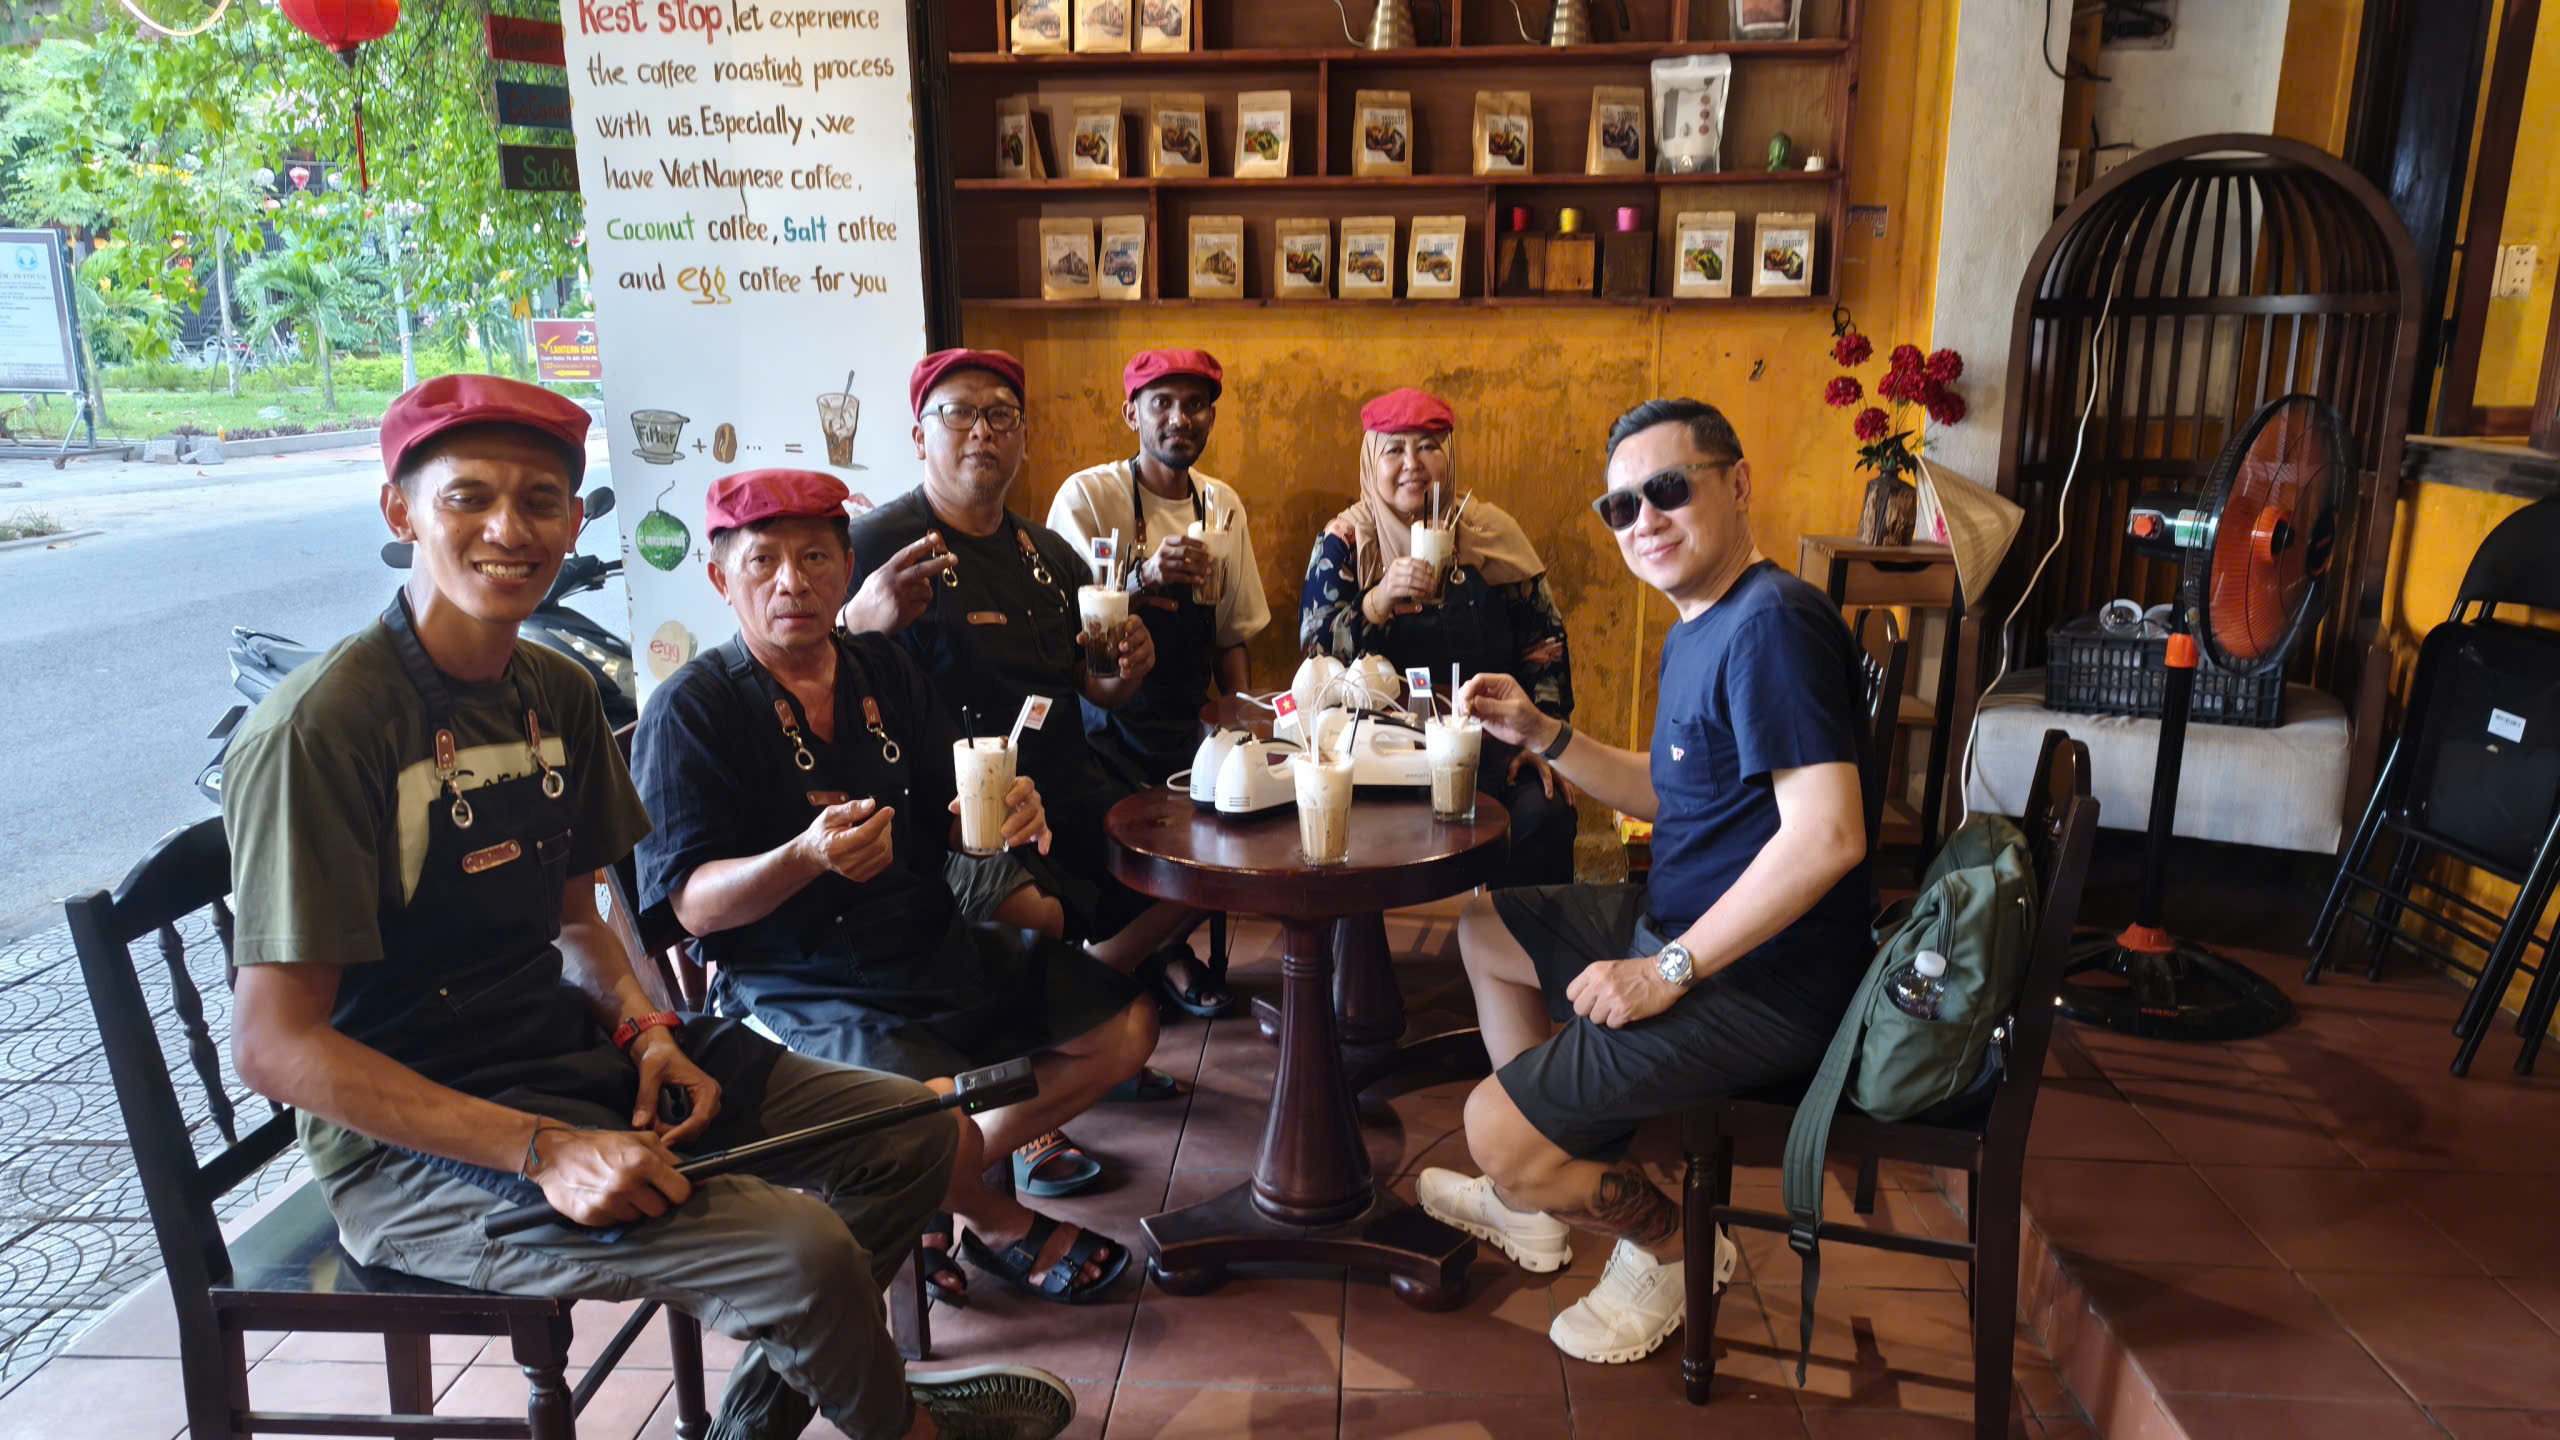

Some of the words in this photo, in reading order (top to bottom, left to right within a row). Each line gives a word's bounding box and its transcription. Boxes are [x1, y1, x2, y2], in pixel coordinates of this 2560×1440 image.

[578, 0, 648, 35] Rest
[770, 9, 880, 38] experience
[587, 51, 629, 87] the
[638, 59, 698, 88] coffee
[714, 53, 804, 88] roasting
[813, 57, 895, 93] process
[595, 109, 651, 139] with
[523, 155, 573, 188] Salt
[604, 155, 654, 189] have
[606, 211, 695, 241] Coconut
[784, 215, 827, 243] Salt
[838, 215, 898, 243] coffee
[619, 261, 667, 292] and
[677, 265, 732, 305] egg
[739, 265, 801, 293] coffee
[810, 265, 845, 293] for
[850, 272, 888, 298] you
[637, 422, 677, 447] Filter
[650, 639, 681, 665] egg
